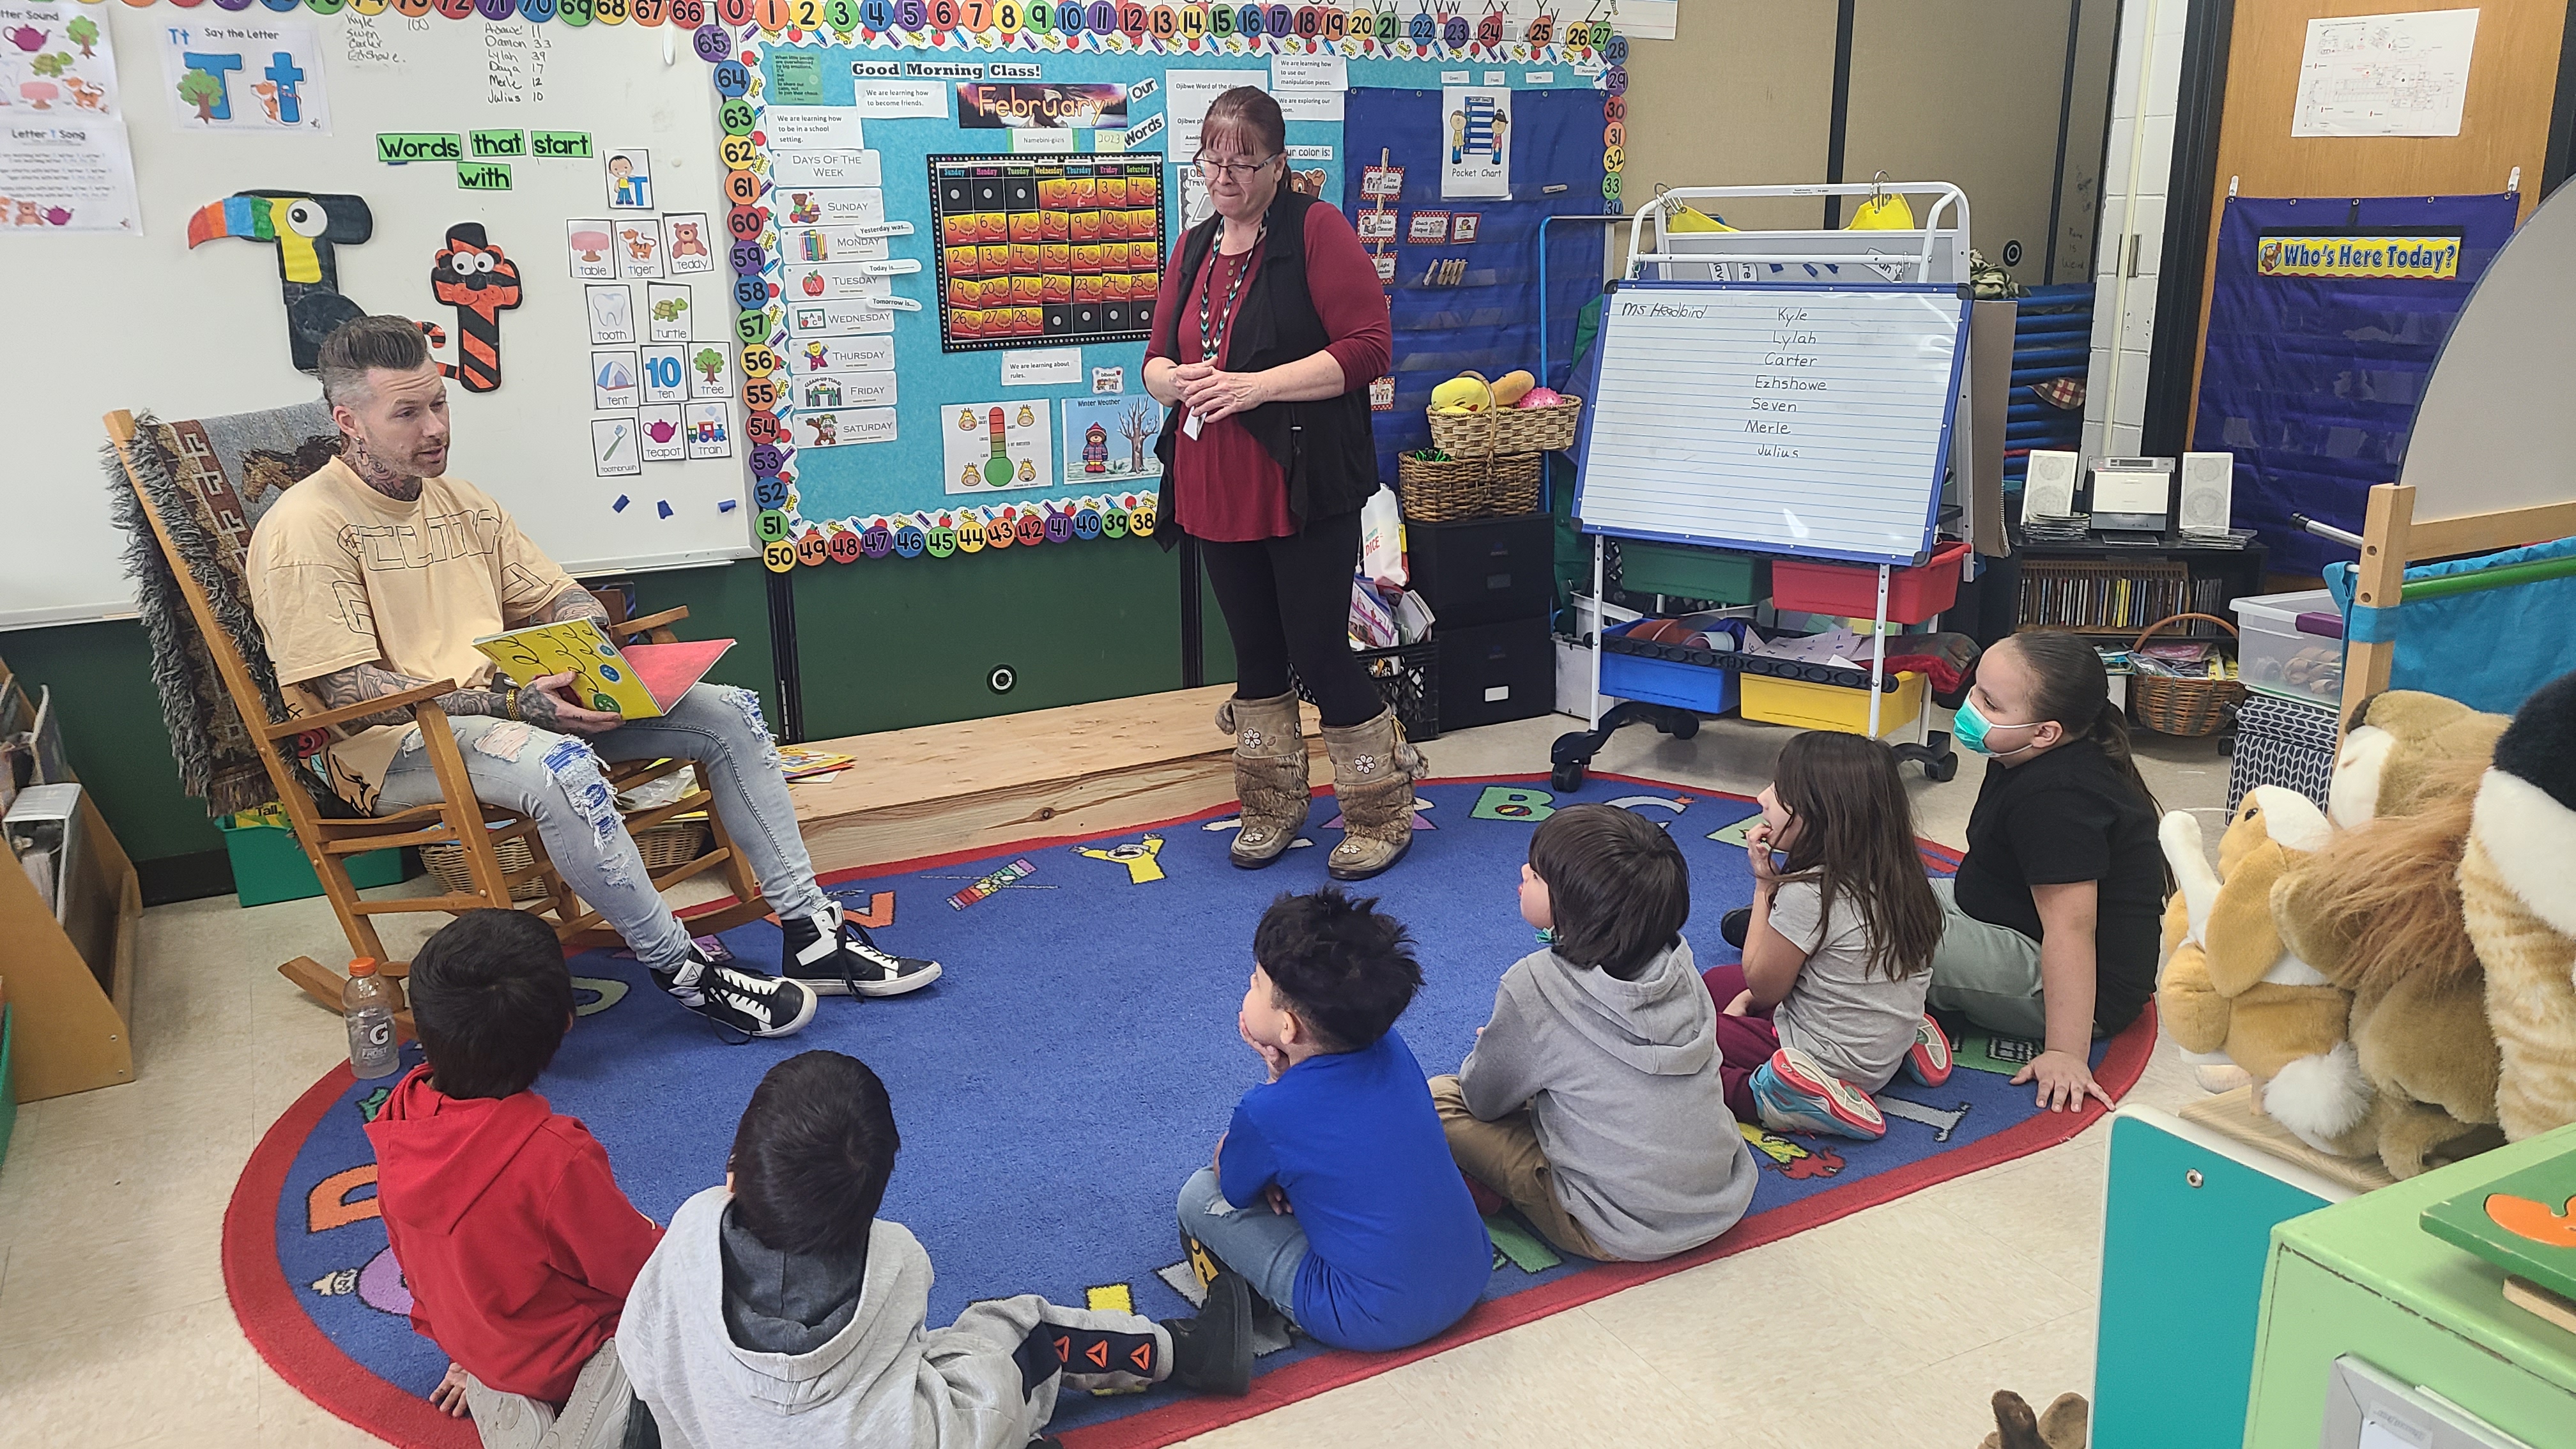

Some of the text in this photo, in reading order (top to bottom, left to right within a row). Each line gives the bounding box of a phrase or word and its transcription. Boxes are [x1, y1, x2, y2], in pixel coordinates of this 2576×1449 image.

[26, 10, 59, 20] Sound
[673, 1, 702, 22] 66
[800, 3, 815, 25] 2
[904, 3, 919, 25] 5
[1002, 4, 1015, 26] 8
[408, 18, 429, 31] 100
[1124, 10, 1143, 31] 12
[1213, 10, 1230, 30] 15
[204, 28, 279, 40] Say the Letter
[532, 25, 541, 39] 11
[1412, 21, 1434, 37] 22
[485, 34, 551, 49] Damon 33
[700, 32, 727, 54] 65
[1569, 28, 1588, 45] 26
[487, 49, 546, 64] Lylah 39
[489, 61, 544, 77] Daya 17
[852, 63, 1040, 79] Good Morning Class!
[489, 74, 543, 90] Merle 12
[487, 89, 544, 104] Julius 10
[890, 89, 914, 98] learning
[1131, 79, 1155, 100] Our
[978, 86, 1106, 126] February
[801, 114, 827, 123] learning
[12, 130, 47, 138] Letter
[59, 130, 86, 141] Song
[1125, 117, 1163, 146] Words
[379, 132, 588, 159] Words that start
[779, 135, 803, 144] setting.
[1098, 134, 1120, 144] 2023
[793, 155, 821, 164] DAYS
[1298, 148, 1320, 157] color
[1606, 150, 1623, 169] 32
[458, 165, 510, 188] with
[813, 168, 843, 176] WEEK
[944, 168, 965, 177] Sunday
[1007, 167, 1029, 176] Tuesday
[1034, 166, 1062, 176] Wednesday
[1066, 166, 1091, 176] Thursday
[1126, 165, 1150, 174] Saturday
[1452, 169, 1501, 177] Pocket Chart
[1131, 179, 1139, 192] 4
[828, 202, 868, 211] SUNDAY
[732, 213, 760, 233] 60
[1102, 212, 1114, 224] 10
[860, 226, 890, 234] Yesterday
[1073, 247, 1085, 261] 16
[2284, 245, 2455, 273] Who's Here Today?
[579, 265, 607, 275] table
[628, 264, 654, 277] tiger
[677, 259, 708, 270] teddy
[832, 277, 878, 286] TUESDAY
[1015, 310, 1027, 323] 28
[1650, 303, 1708, 319] Headbird
[1777, 308, 1807, 327] Kyle
[739, 315, 764, 336] 57
[828, 313, 890, 324] WEDNESDAY
[598, 330, 627, 341] tooth
[656, 329, 687, 339] turtle
[1773, 332, 1816, 349] Lylah
[832, 351, 885, 360] THURSDAY
[1764, 352, 1818, 367] Carter
[645, 356, 682, 388] 10
[701, 385, 724, 395] tree
[1755, 375, 1827, 391] Ezhshowe
[657, 390, 675, 399] ten
[850, 387, 885, 395] FRIDAY
[607, 395, 629, 406] tent
[1751, 398, 1797, 412] Seven
[749, 418, 776, 438] 54
[843, 422, 893, 433] SATURDAY
[1745, 420, 1791, 434] Merle
[646, 447, 682, 459] teapot
[698, 446, 723, 455] train
[1757, 444, 1798, 459] Julius
[601, 464, 638, 473] toothbrush
[1049, 514, 1068, 533] 41
[862, 532, 887, 551] 47
[1366, 536, 1380, 556] DICE
[767, 546, 794, 567] 50
[369, 1022, 389, 1045] G
[362, 1046, 388, 1057] FROST
